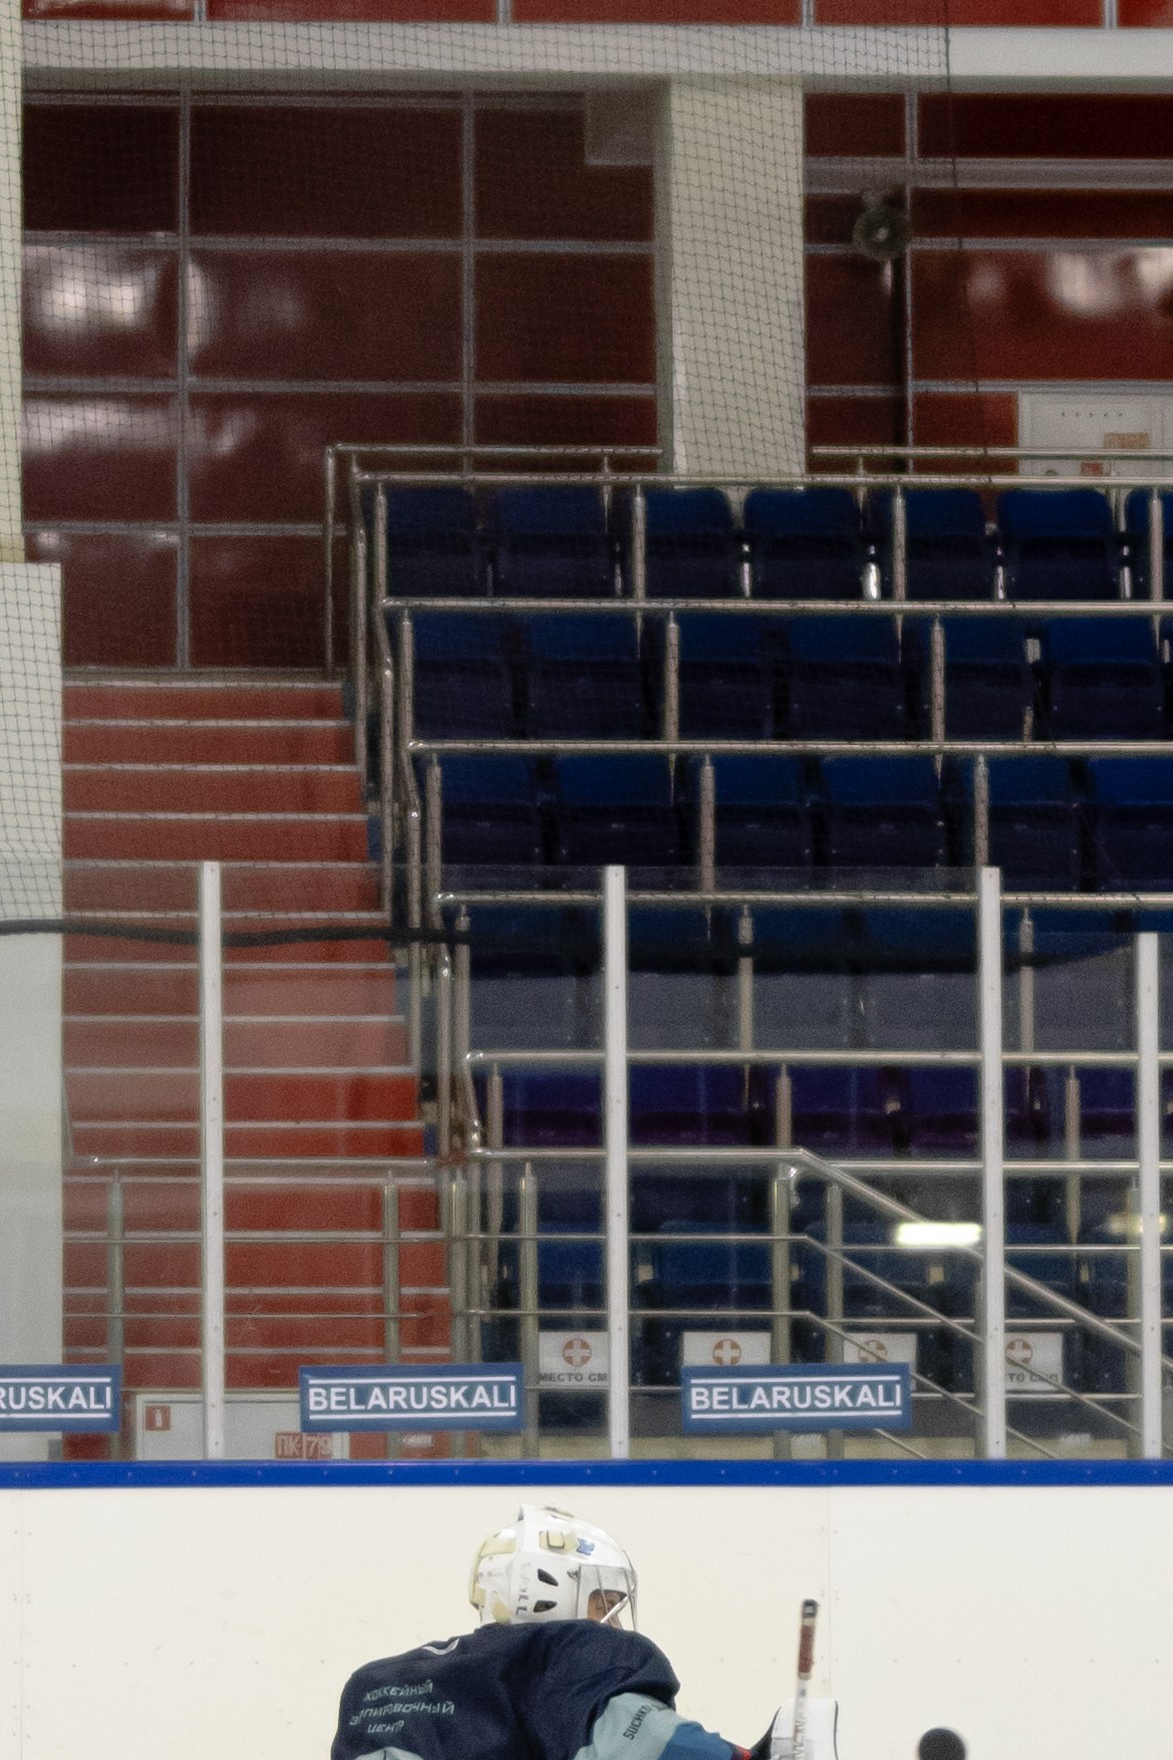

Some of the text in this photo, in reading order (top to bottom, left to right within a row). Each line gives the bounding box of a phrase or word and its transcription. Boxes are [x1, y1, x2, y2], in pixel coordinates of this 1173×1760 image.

[308, 1385, 516, 1411] BELARUSKALI
[690, 1383, 902, 1410] BELARUSKALI
[367, 1719, 405, 1734] ЦЕНТР
